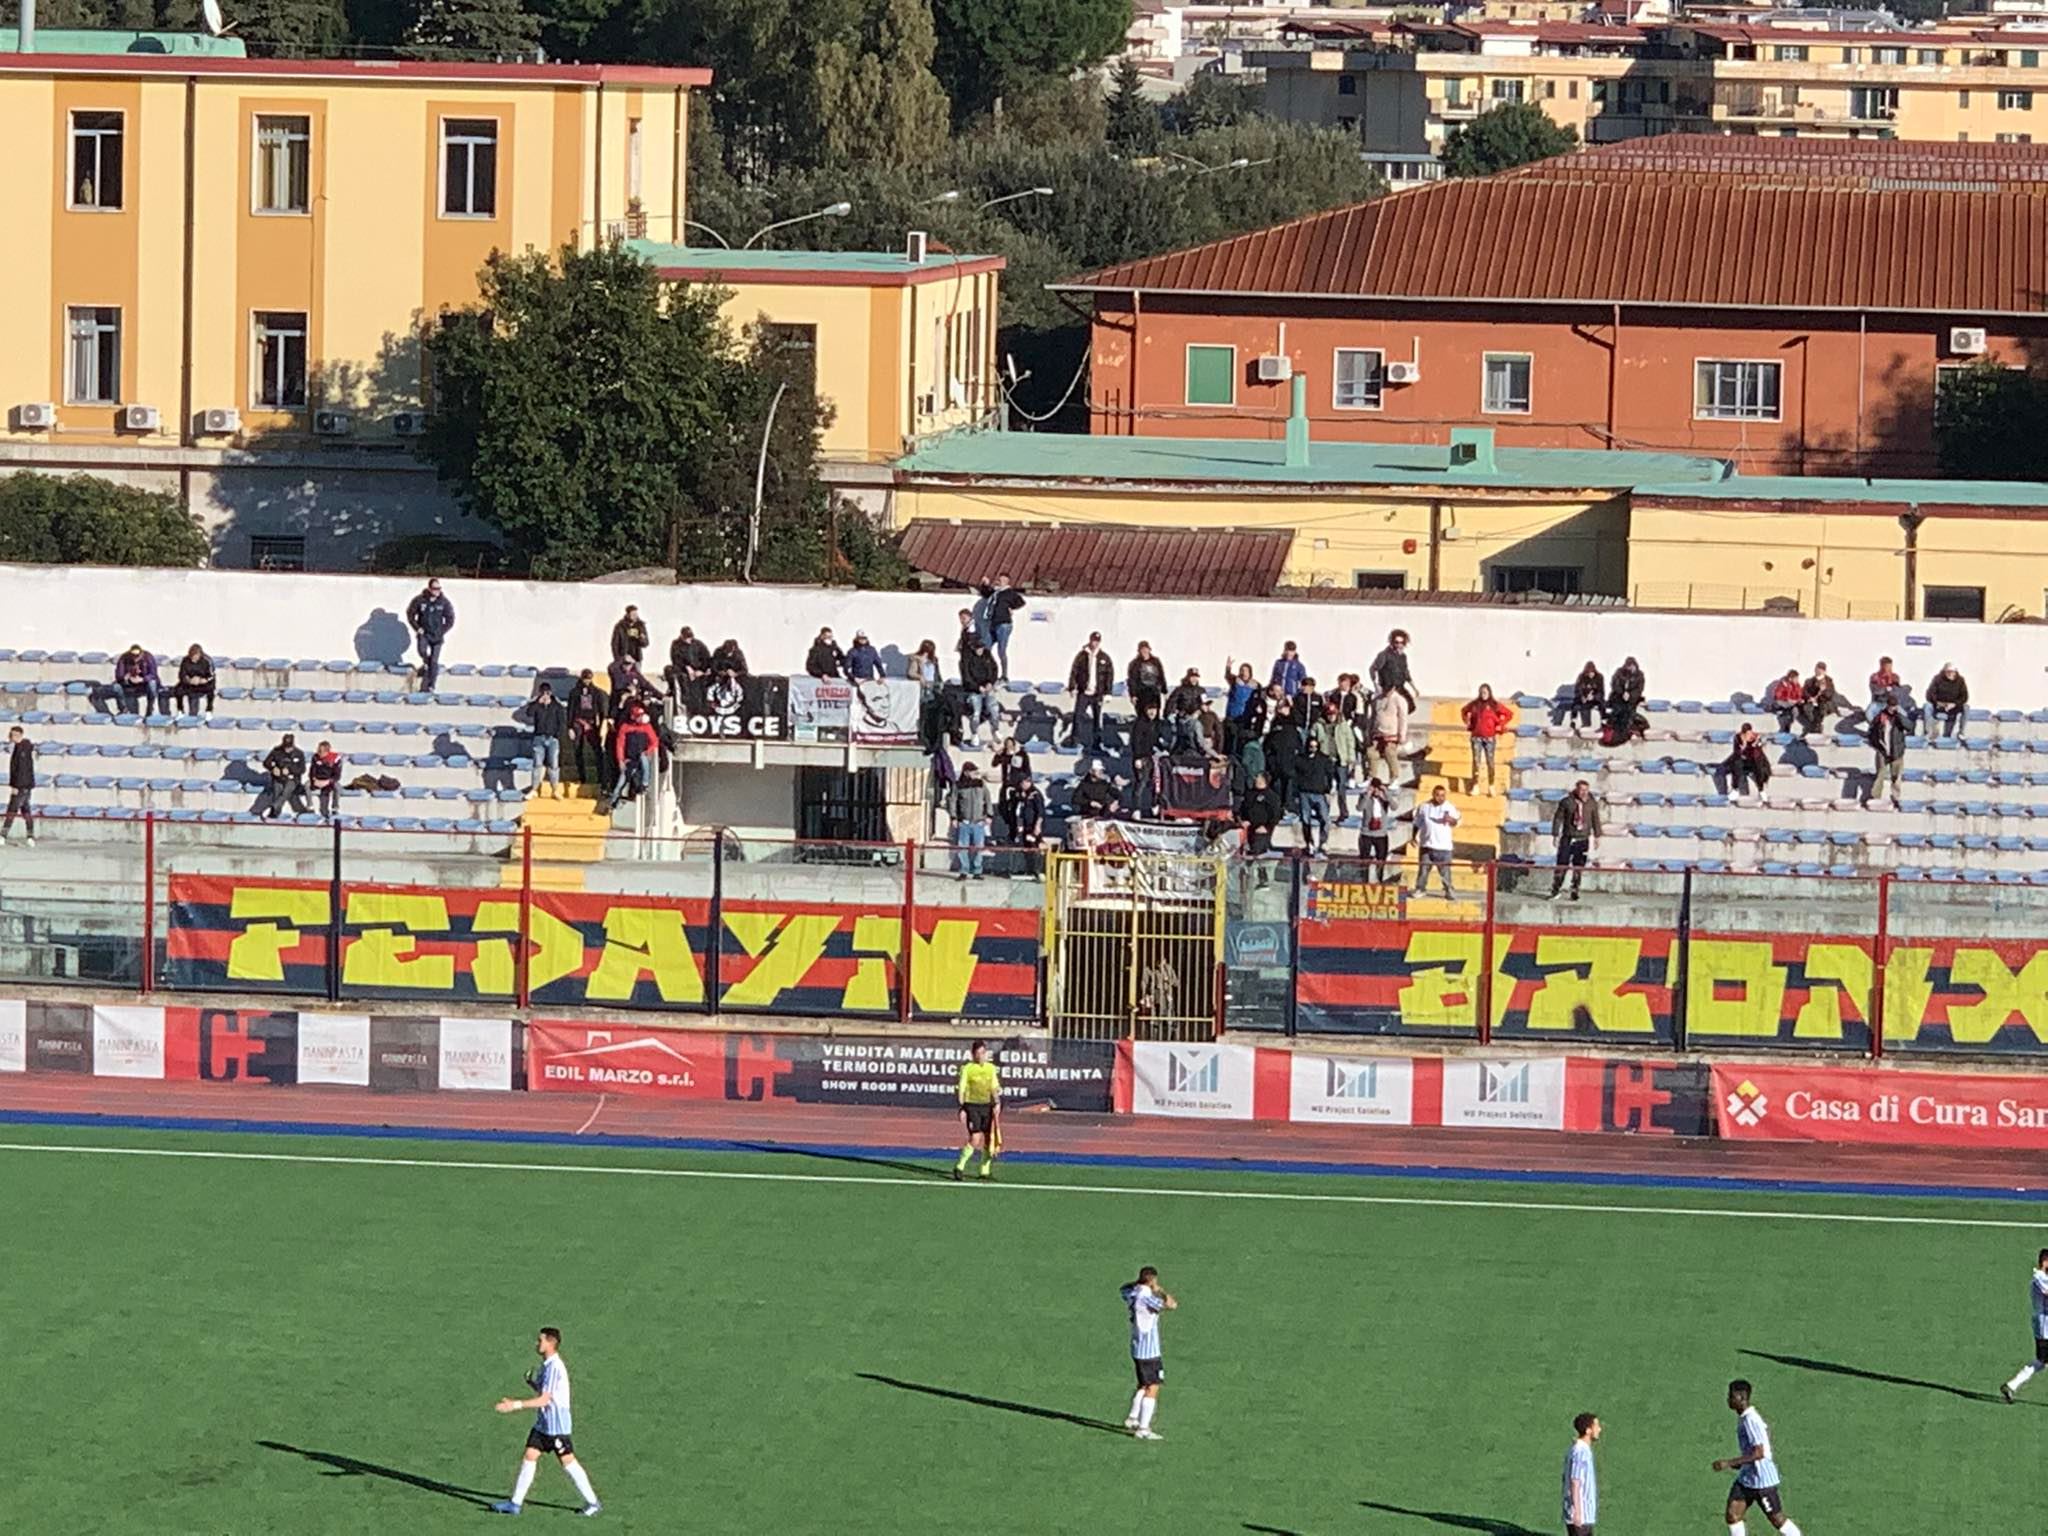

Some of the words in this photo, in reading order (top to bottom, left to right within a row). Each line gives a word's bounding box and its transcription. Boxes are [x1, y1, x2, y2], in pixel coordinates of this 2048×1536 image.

[673, 715, 742, 735] BOYS
[748, 716, 779, 736] CE
[1316, 881, 1399, 904] CURVA
[1315, 903, 1399, 920] PARADISO
[227, 886, 979, 1012] FEDAYN
[1399, 930, 2048, 1043] BRONX
[822, 1044, 895, 1059] VENDITA
[900, 1047, 993, 1062] MATERIAE
[1000, 1051, 1047, 1064] EDILE
[545, 1064, 584, 1080] EDIL
[589, 1067, 653, 1084] MARZO
[657, 1071, 694, 1086] s.r.l.
[822, 1060, 960, 1076] TERMOIDRAULIC
[822, 1080, 858, 1091] SHOW
[861, 1081, 897, 1092] ROOM
[1785, 1090, 1861, 1121] Casa
[1869, 1094, 1900, 1123] di
[1908, 1095, 1989, 1126] Cura
